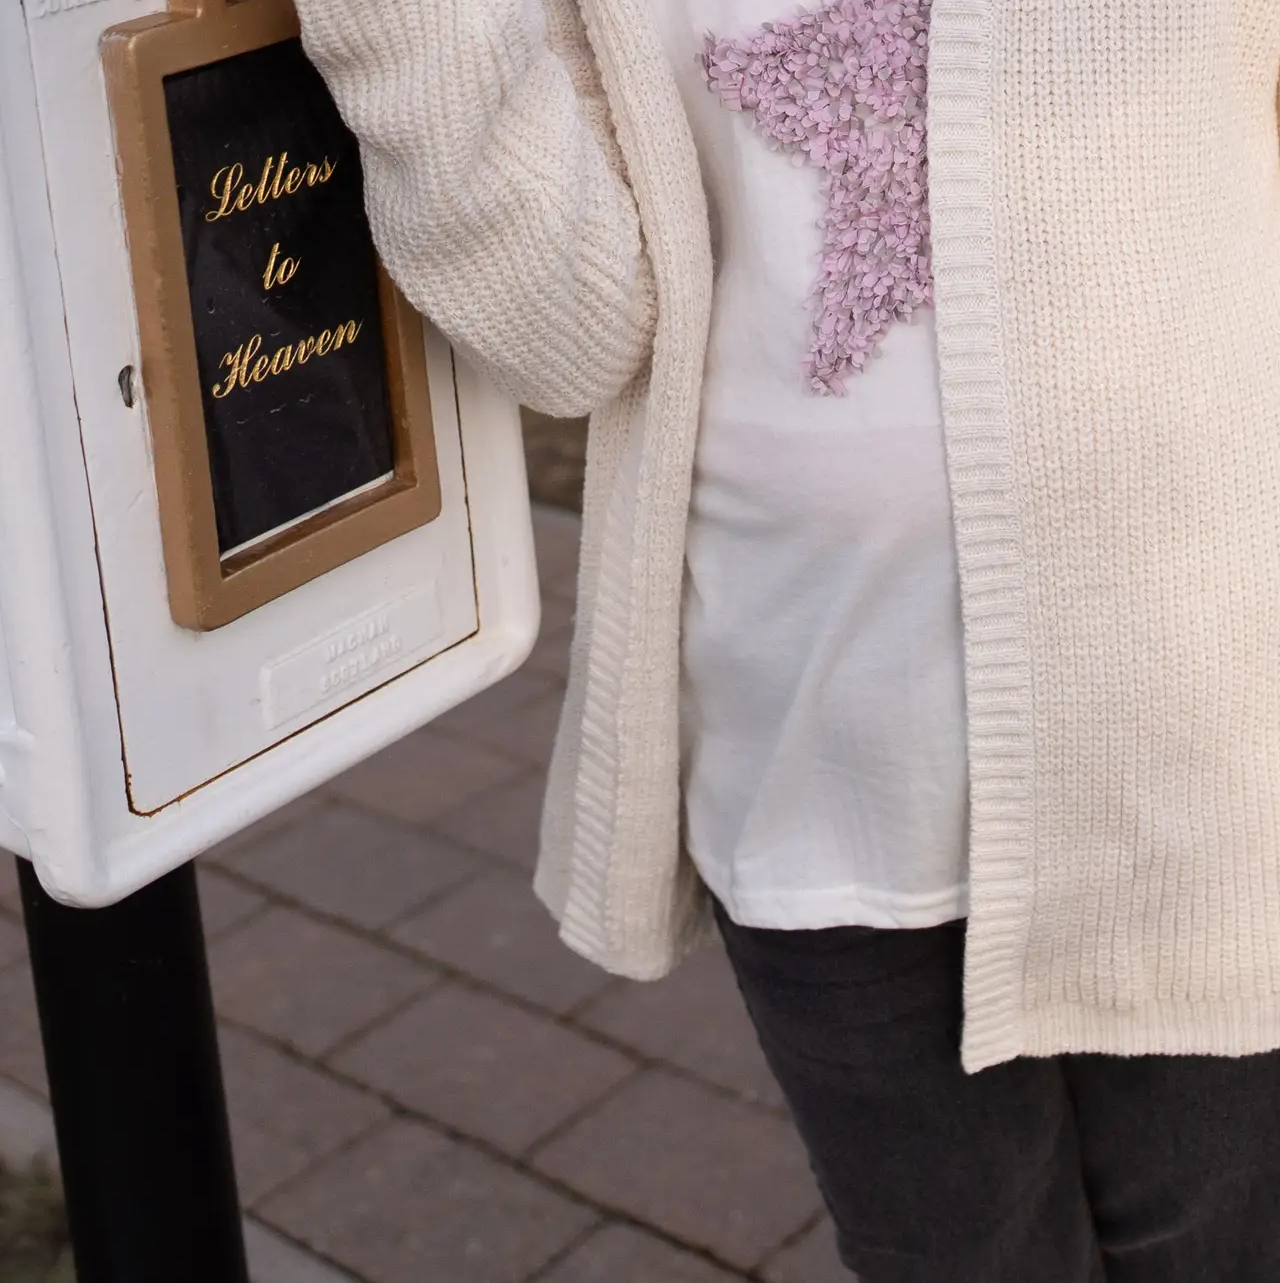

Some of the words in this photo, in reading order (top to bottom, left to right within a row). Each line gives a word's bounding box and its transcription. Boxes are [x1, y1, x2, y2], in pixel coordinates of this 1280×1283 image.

[205, 151, 338, 223] Letters
[262, 242, 303, 292] to
[211, 317, 364, 400] Heaven
